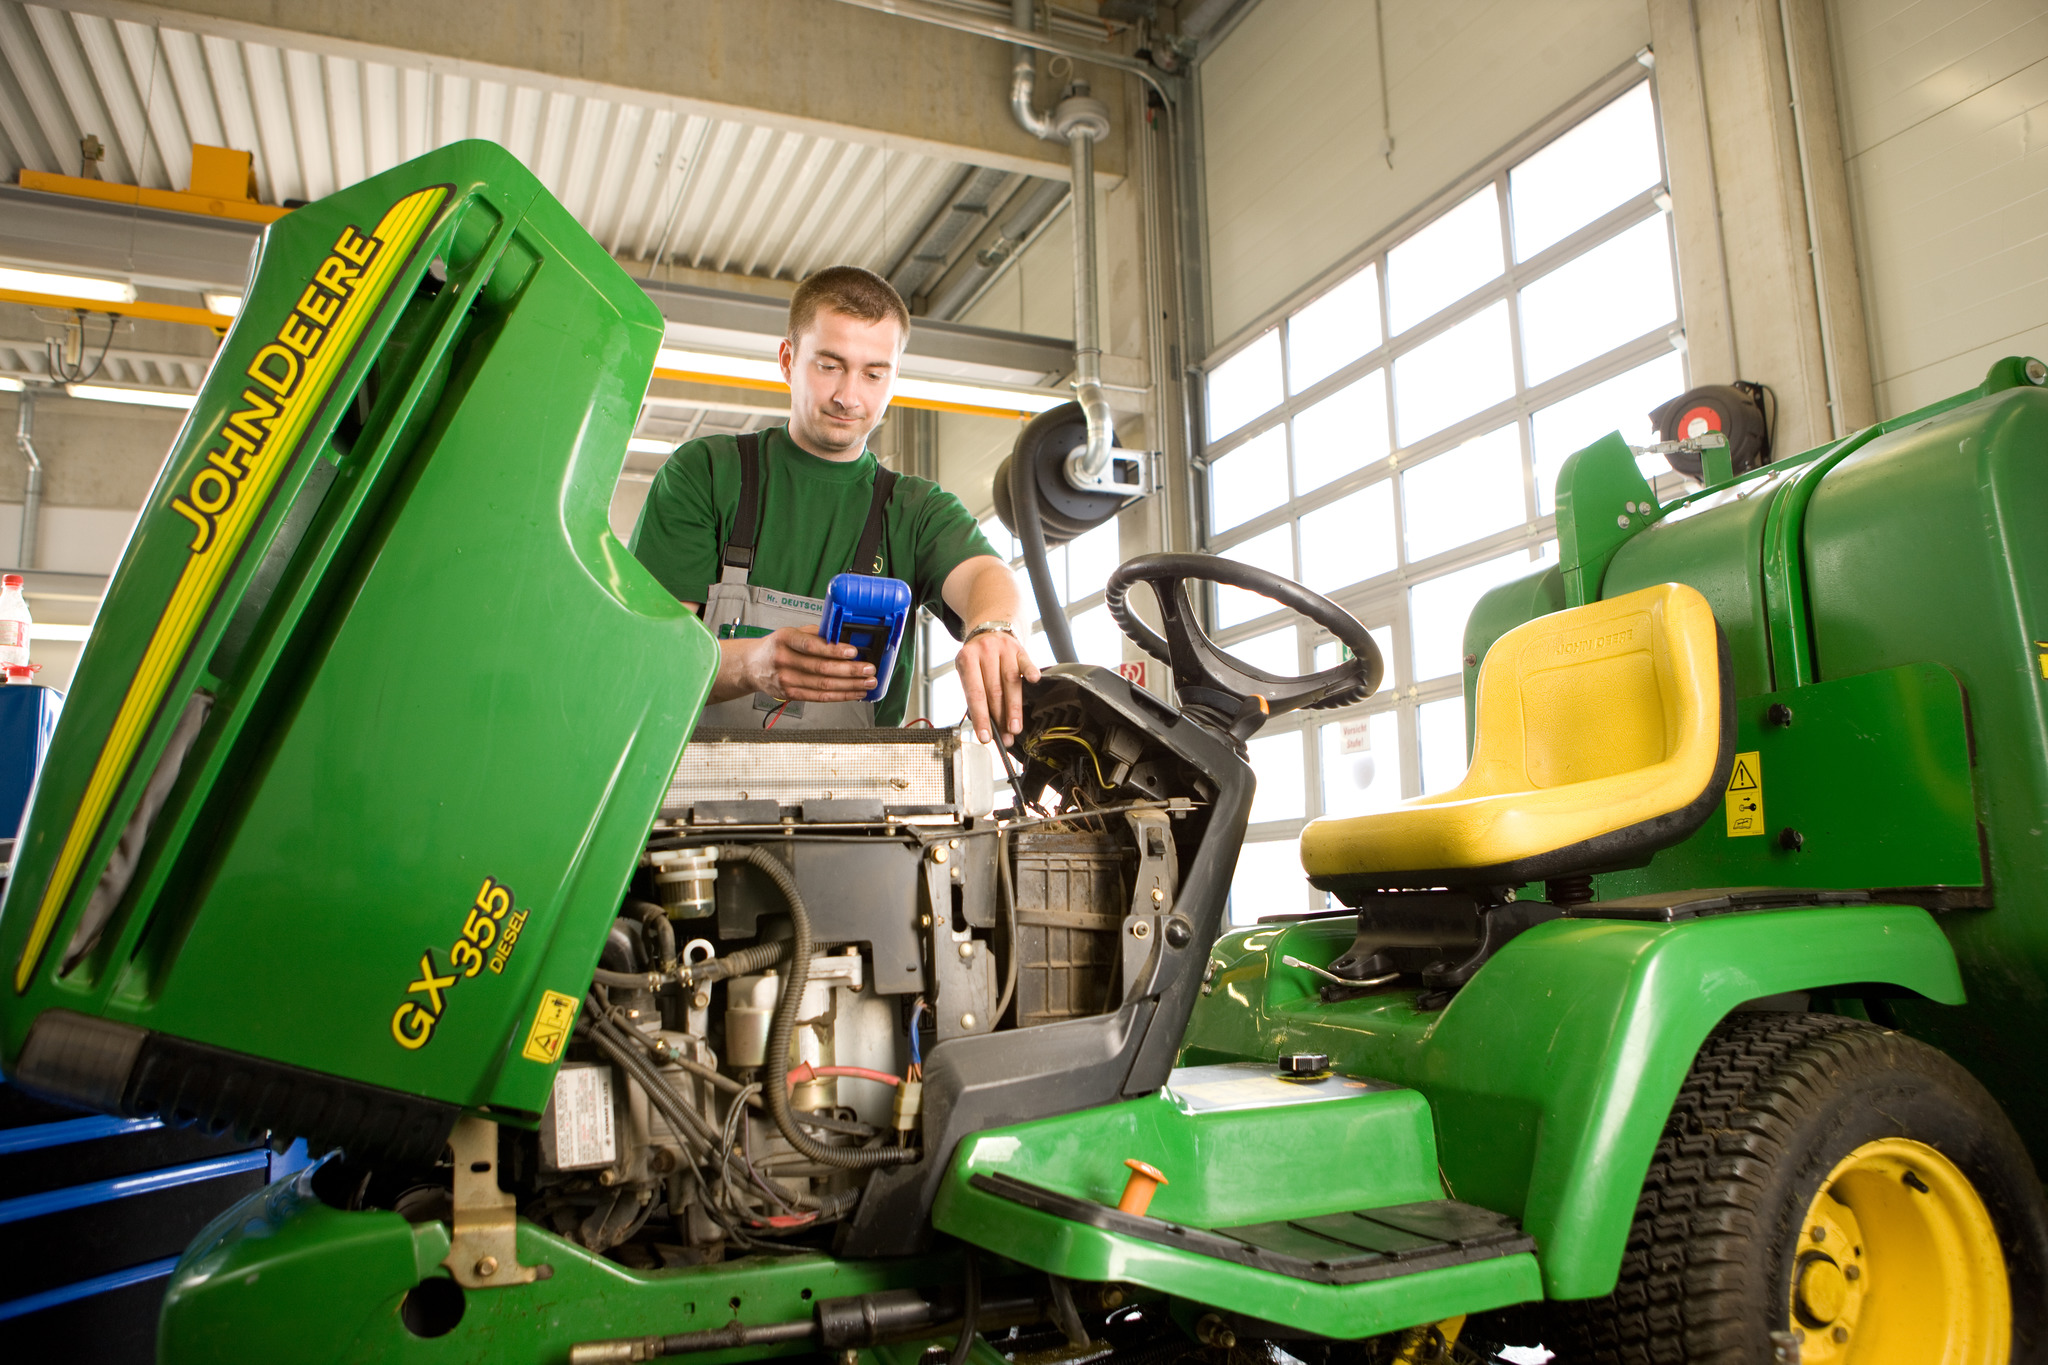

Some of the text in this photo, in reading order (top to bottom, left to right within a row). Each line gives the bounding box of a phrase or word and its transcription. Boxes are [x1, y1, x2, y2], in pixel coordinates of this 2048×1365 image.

[169, 225, 384, 553] JOHN DEERE
[766, 594, 823, 612] Hr. DEUTSCH
[391, 876, 514, 1050] GX 355
[489, 909, 530, 974] DIESEL
